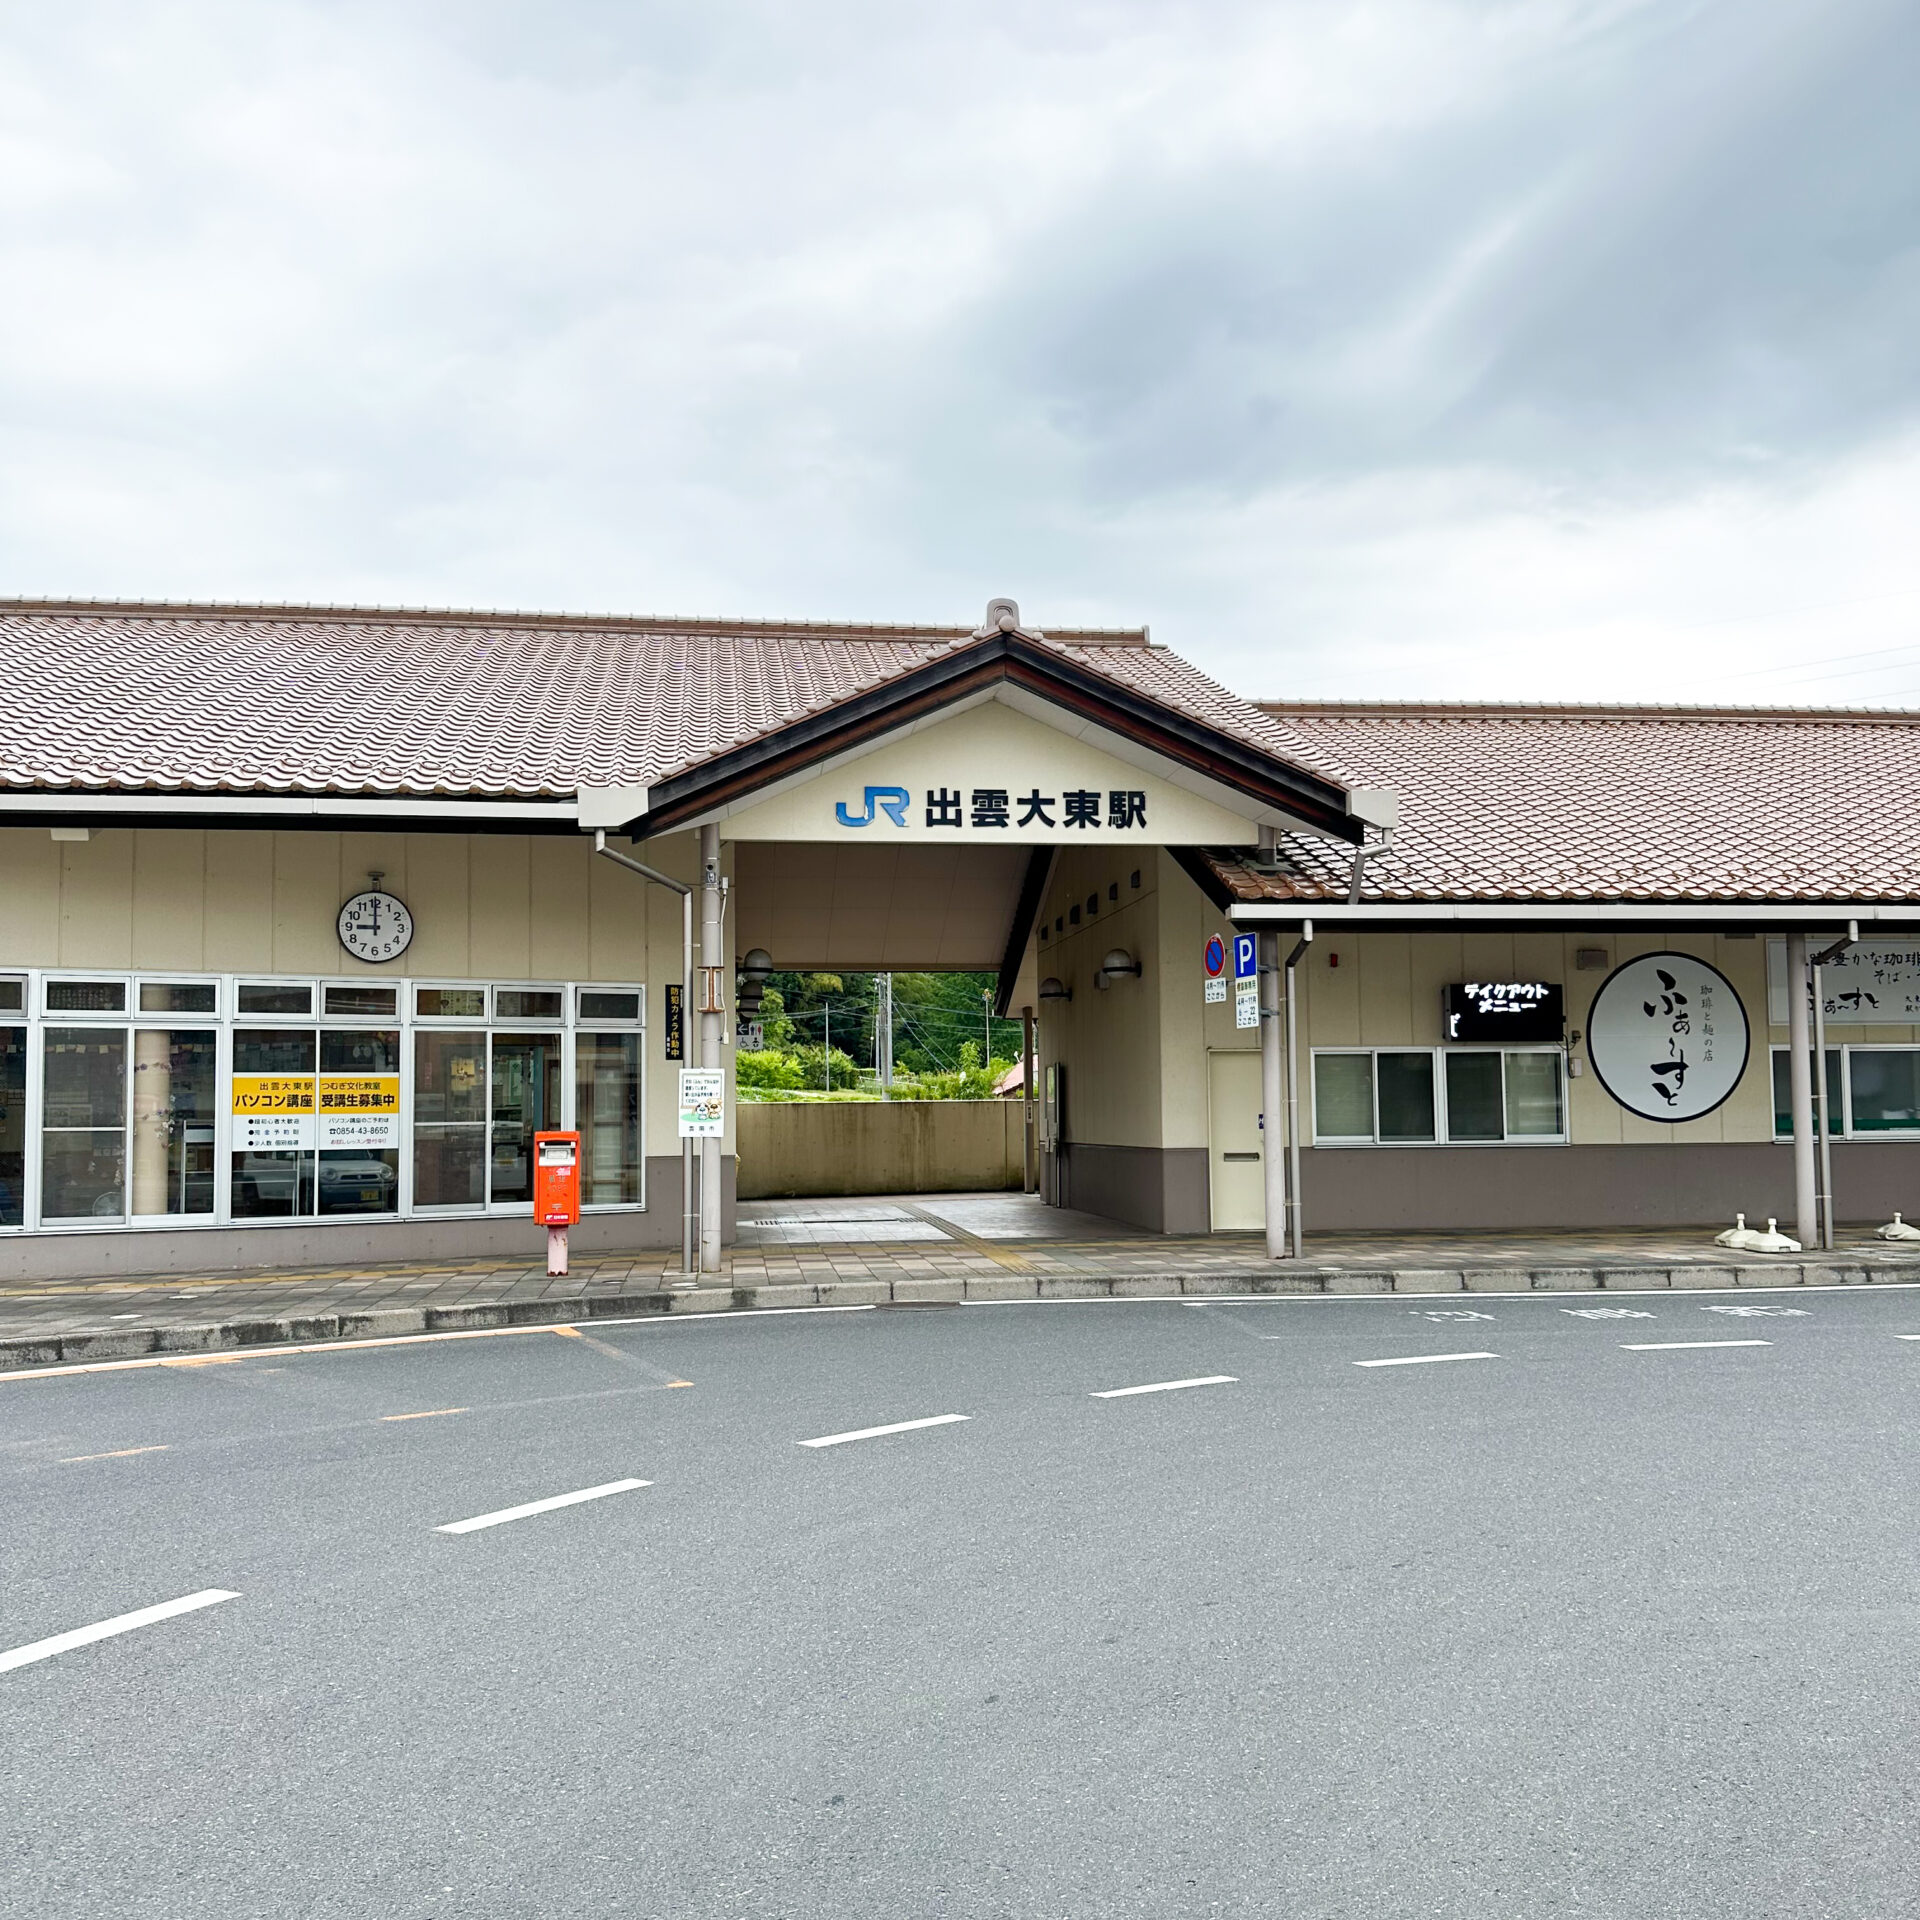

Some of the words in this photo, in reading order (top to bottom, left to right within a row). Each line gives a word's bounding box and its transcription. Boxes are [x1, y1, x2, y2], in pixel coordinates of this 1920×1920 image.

[836, 786, 910, 827] JR
[926, 788, 1148, 829] 出雲大東駅
[357, 902, 367, 911] 11
[386, 904, 391, 912] 1
[348, 911, 360, 920] 10
[394, 912, 401, 921] 2
[345, 922, 353, 931] 9
[397, 924, 405, 933] 3
[349, 934, 357, 943] 8
[393, 936, 400, 944] 4
[360, 943, 367, 952] 7
[371, 946, 379, 956] 6
[384, 943, 391, 952] 5
[1239, 939, 1252, 974] P
[1464, 984, 1549, 999] テイクアウト
[1479, 999, 1537, 1013] メニュー
[670, 986, 680, 1057] 防犯カメラ作動中
[259, 1082, 313, 1091] 出雲大東駅
[235, 1094, 313, 1108] パソコン講座
[321, 1093, 395, 1108] 受講生募集中
